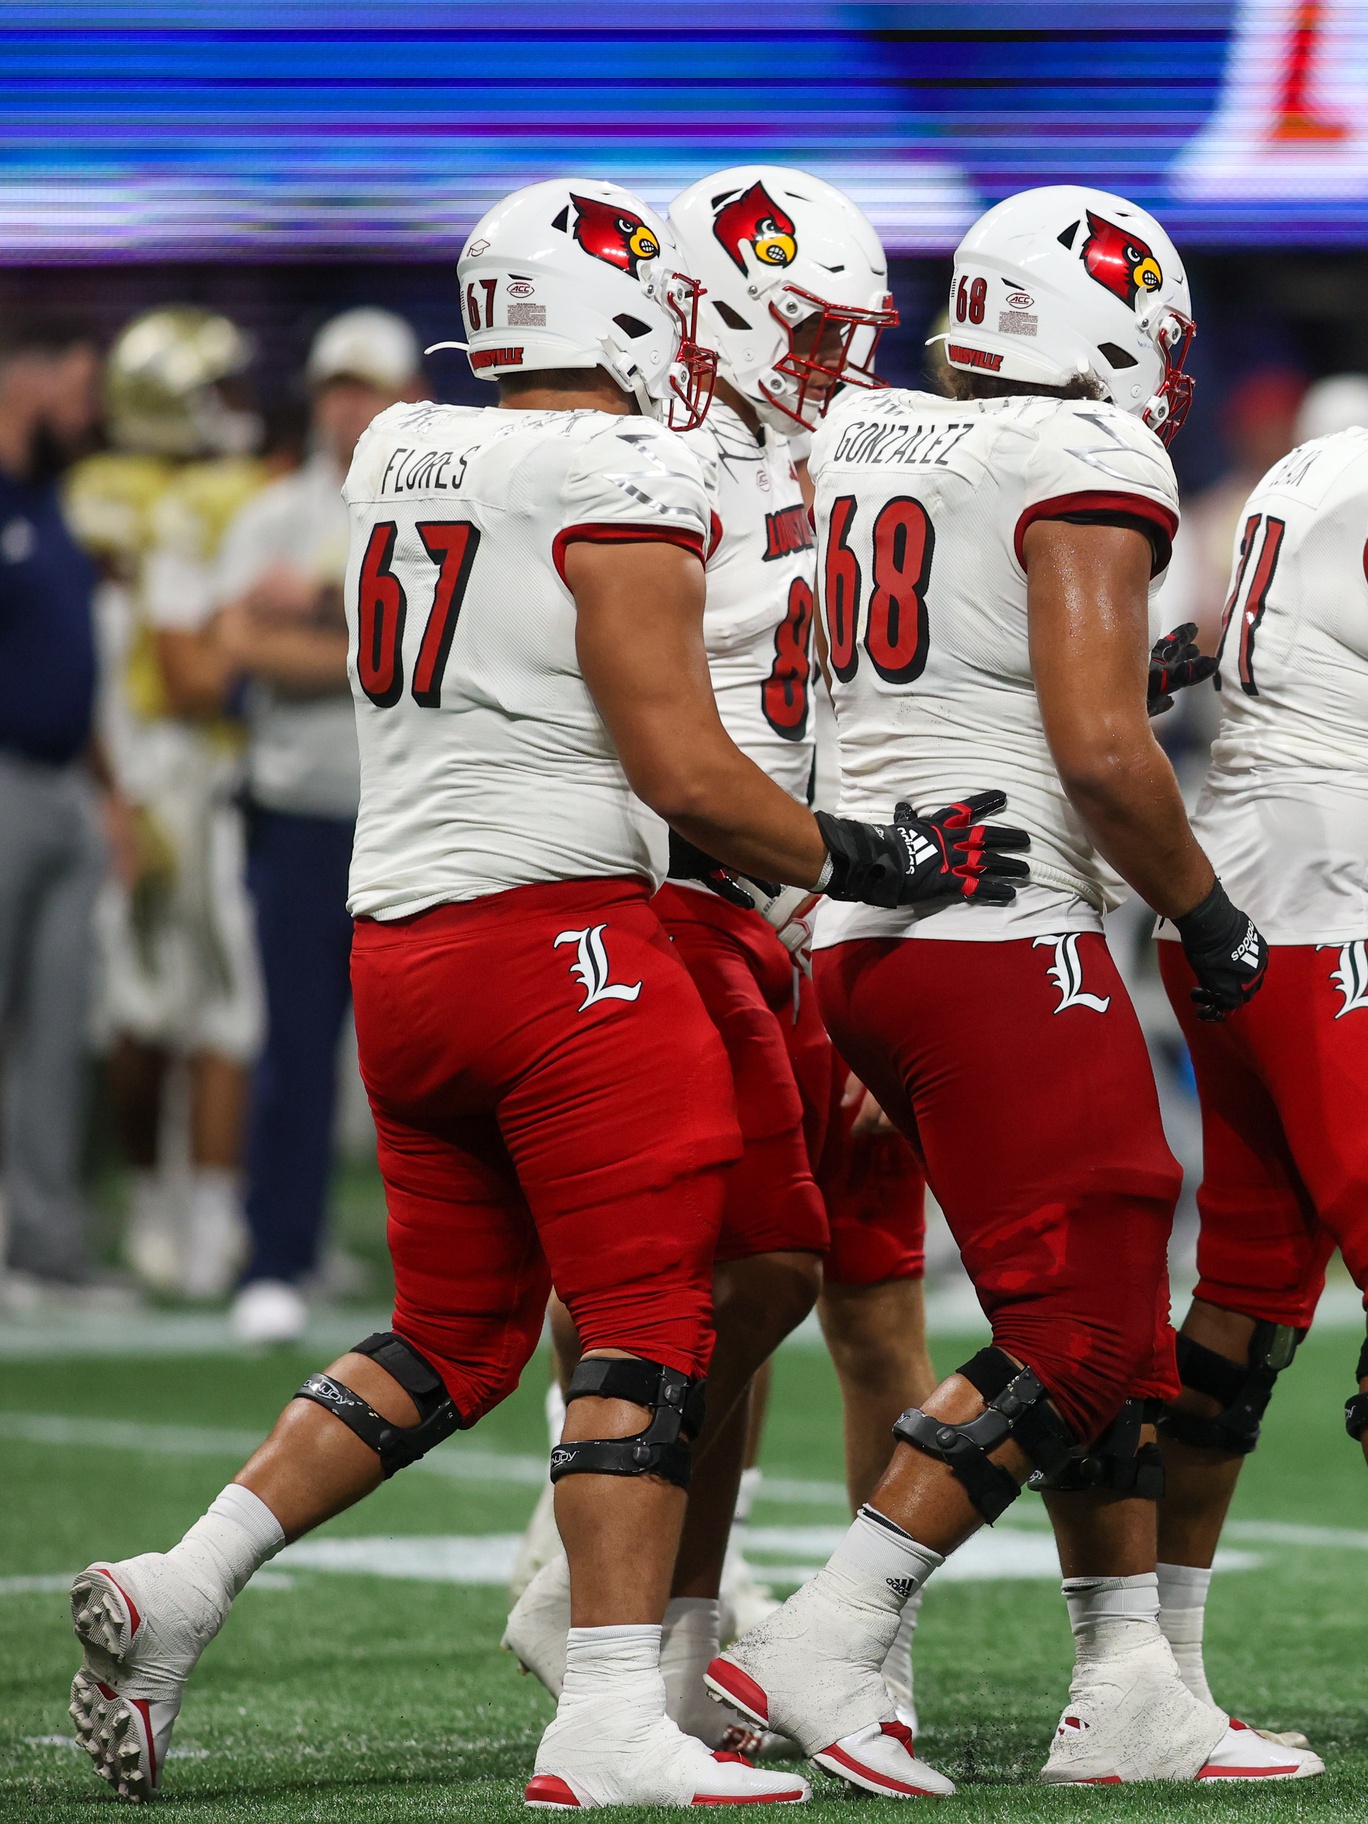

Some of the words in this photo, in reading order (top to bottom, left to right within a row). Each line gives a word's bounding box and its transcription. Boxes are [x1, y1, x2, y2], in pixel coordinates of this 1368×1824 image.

[467, 279, 498, 331] 67
[956, 275, 987, 325] 68
[1009, 296, 1031, 304] ACC
[833, 421, 975, 466] GONZALEZ
[381, 445, 481, 494] FLORES
[824, 494, 935, 684] 68
[357, 520, 481, 708] 67
[1230, 920, 1254, 961] adidas
